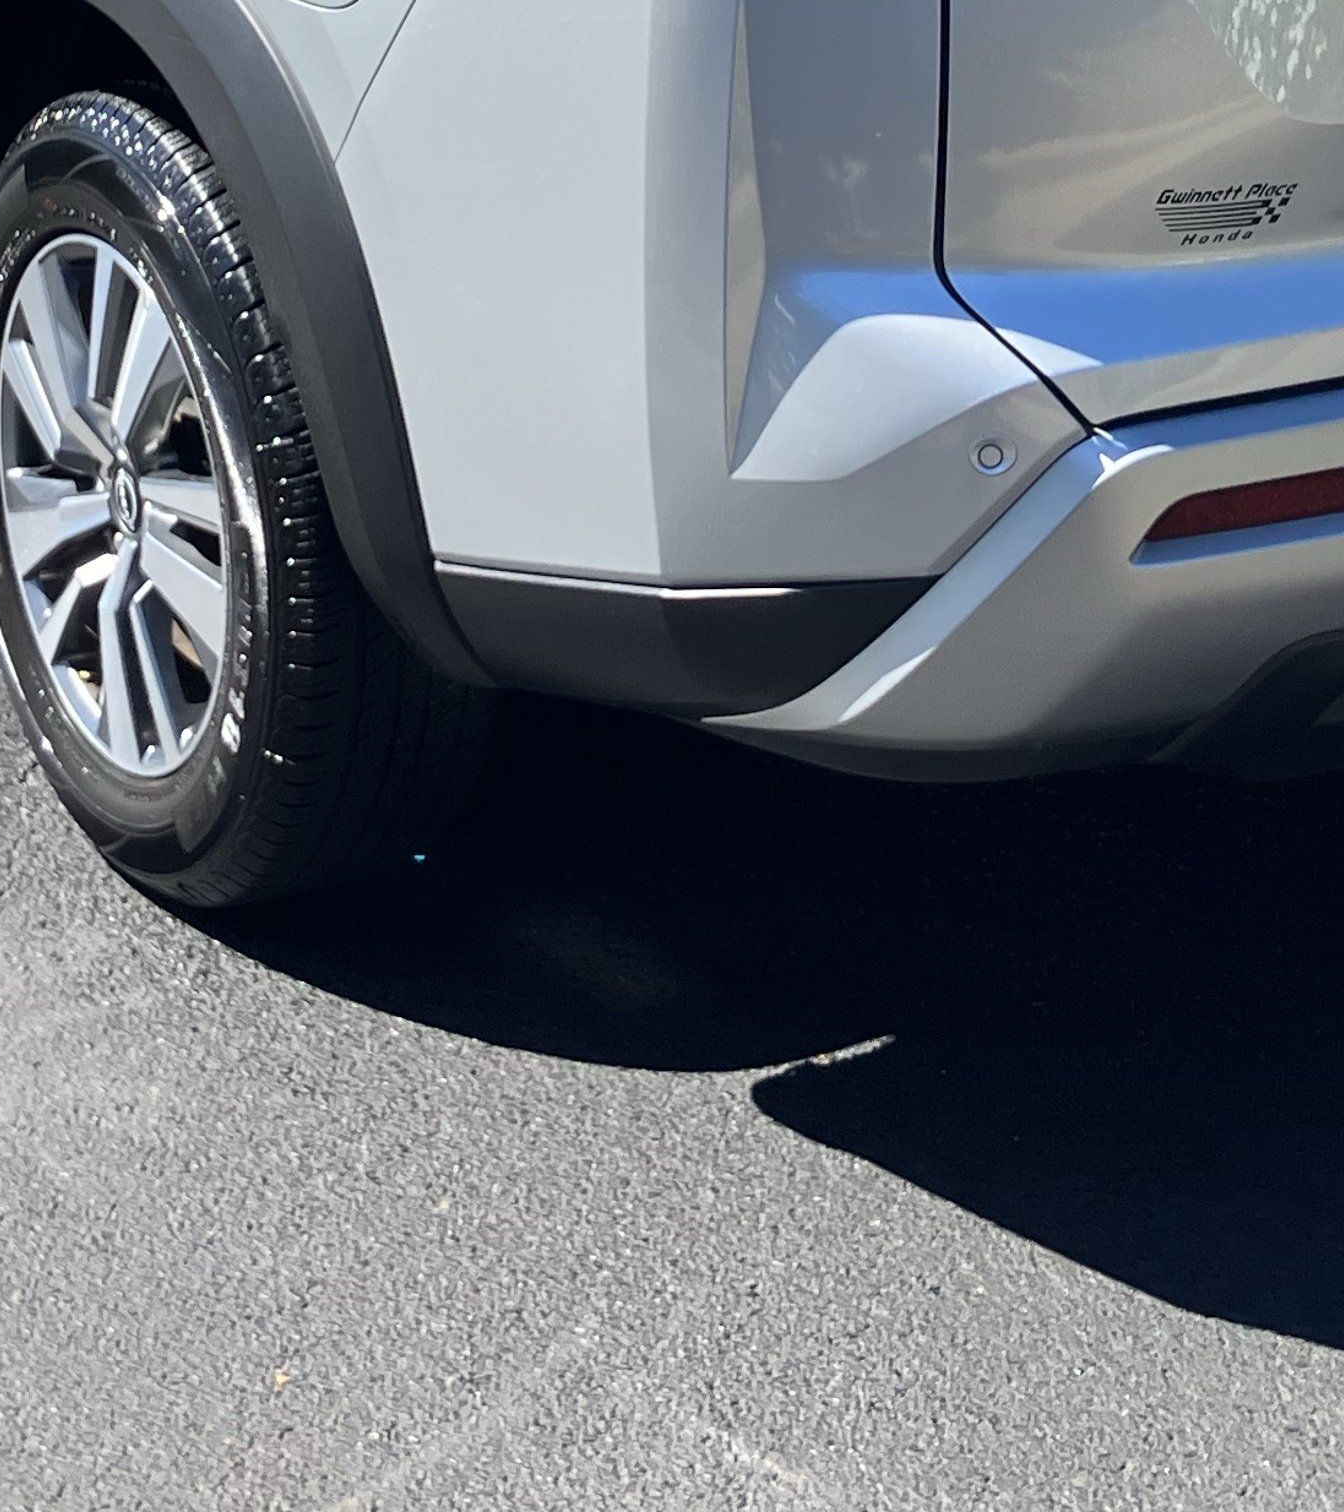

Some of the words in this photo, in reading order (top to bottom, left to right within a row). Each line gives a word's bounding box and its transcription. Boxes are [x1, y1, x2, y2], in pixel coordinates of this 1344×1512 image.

[1156, 185, 1243, 204] Gwinnett
[1244, 182, 1299, 200] Place
[1181, 229, 1254, 246] Honda
